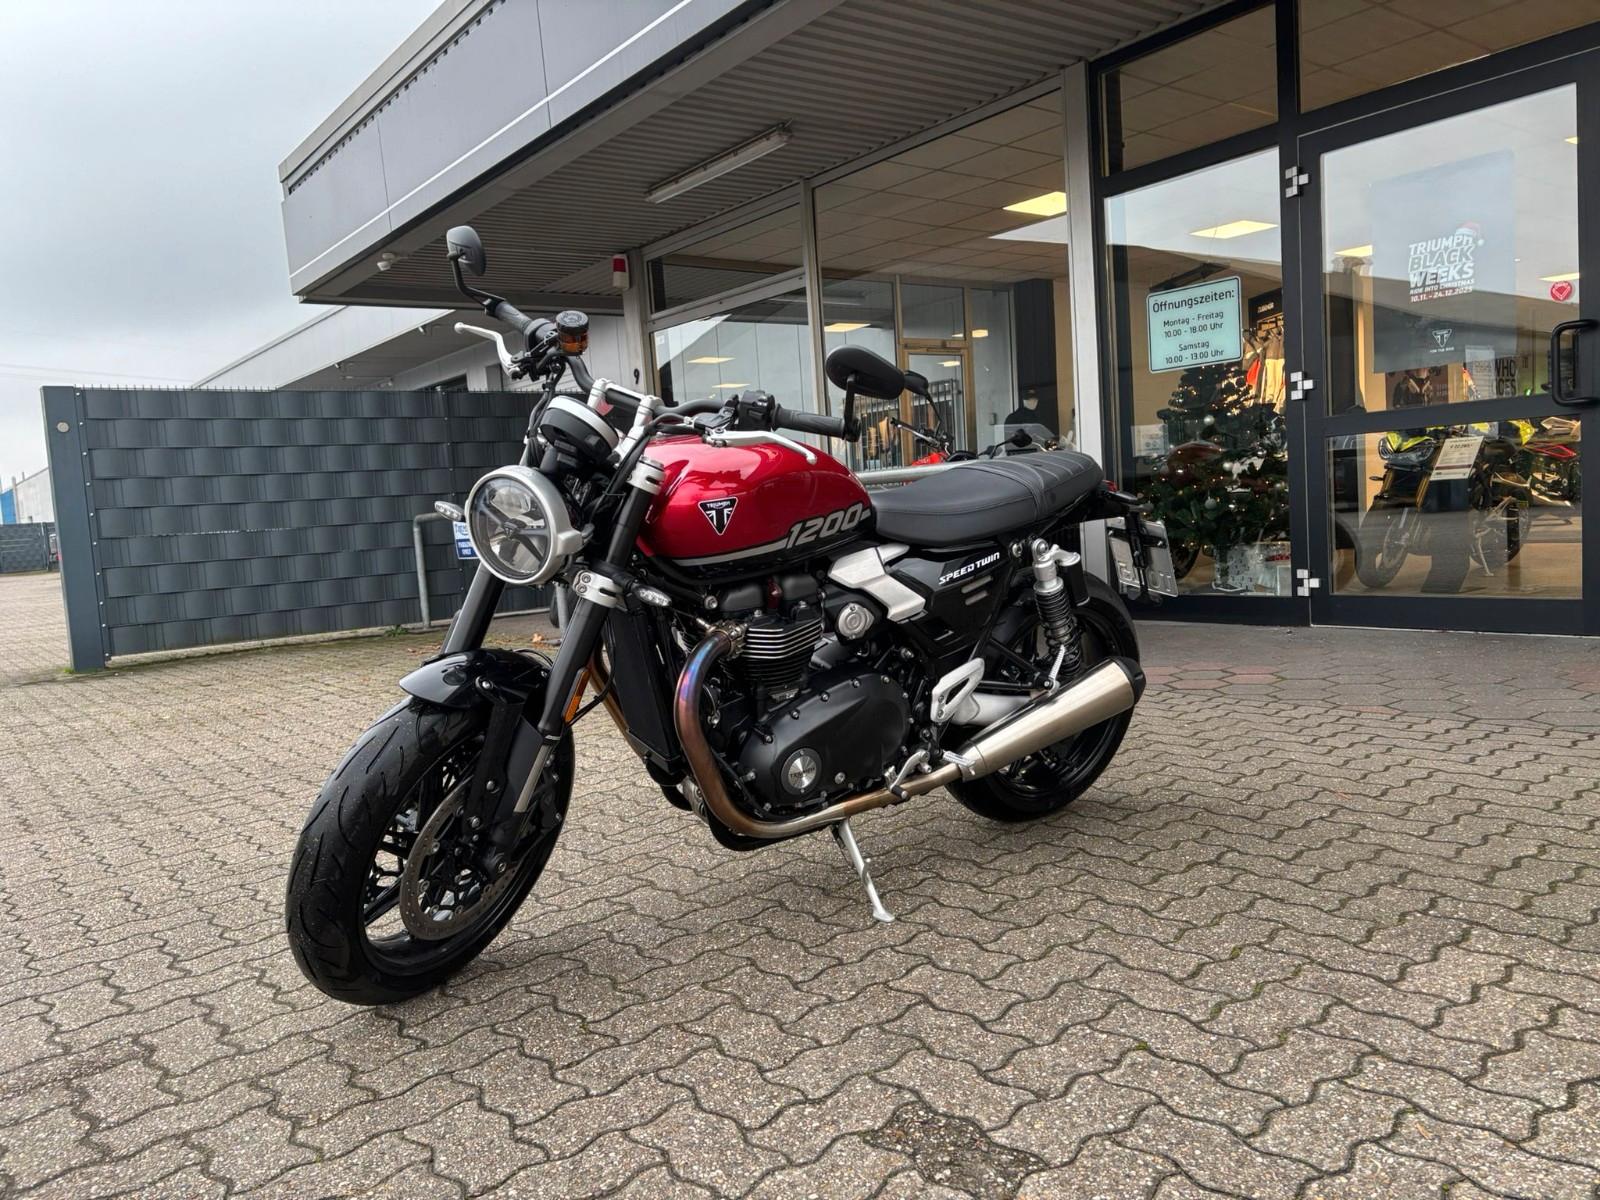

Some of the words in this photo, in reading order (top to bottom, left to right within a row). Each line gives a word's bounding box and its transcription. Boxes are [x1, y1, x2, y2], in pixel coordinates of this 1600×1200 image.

[1409, 234, 1473, 255] TRIUMPH
[1408, 245, 1475, 273] BLACK
[1409, 263, 1474, 288] WEEKS
[1152, 289, 1235, 313] Öffnungszeiten:
[1163, 317, 1190, 328] Montag
[1197, 311, 1224, 321] Freitag
[1164, 329, 1182, 338] 10.00
[1190, 324, 1208, 334] 18.00
[1210, 322, 1224, 330] Uhr
[1179, 341, 1210, 352] Samstag
[1165, 355, 1183, 364] 10.00
[1191, 351, 1209, 360] 13.00
[1210, 349, 1224, 357] Uhr
[633, 368, 640, 385] 9
[706, 500, 731, 509] TRIUMPH
[786, 502, 863, 550] 1200
[938, 563, 975, 585] SPEED
[975, 551, 1000, 568] TWIN
